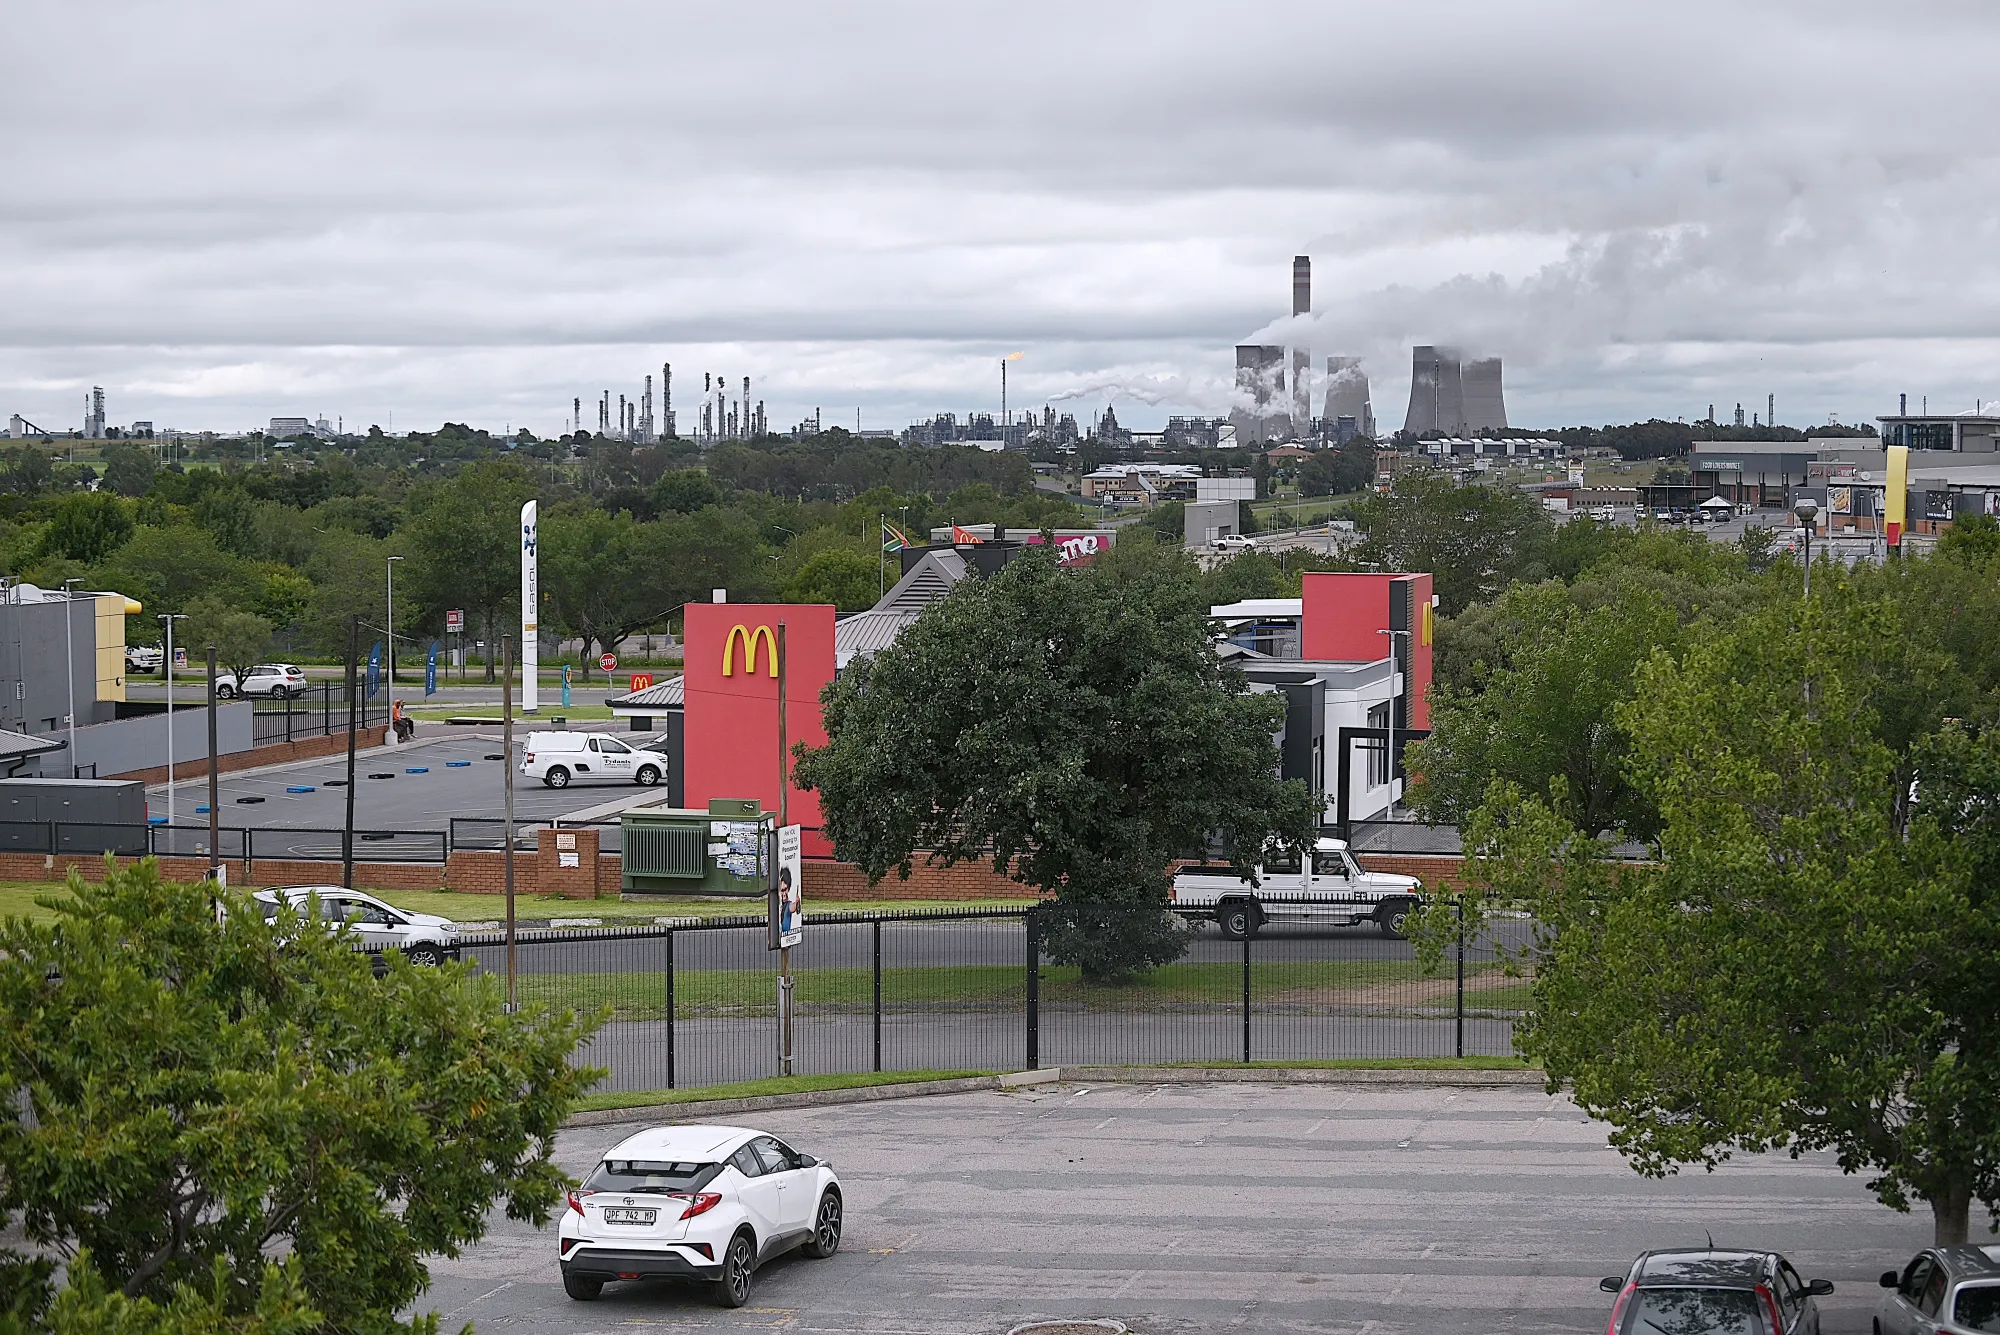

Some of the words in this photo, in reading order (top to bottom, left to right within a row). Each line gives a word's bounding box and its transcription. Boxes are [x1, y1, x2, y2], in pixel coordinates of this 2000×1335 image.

[601, 658, 615, 666] STOP
[606, 1210, 620, 1219] JPF
[625, 1210, 639, 1220] 742
[644, 1211, 654, 1221] MP
